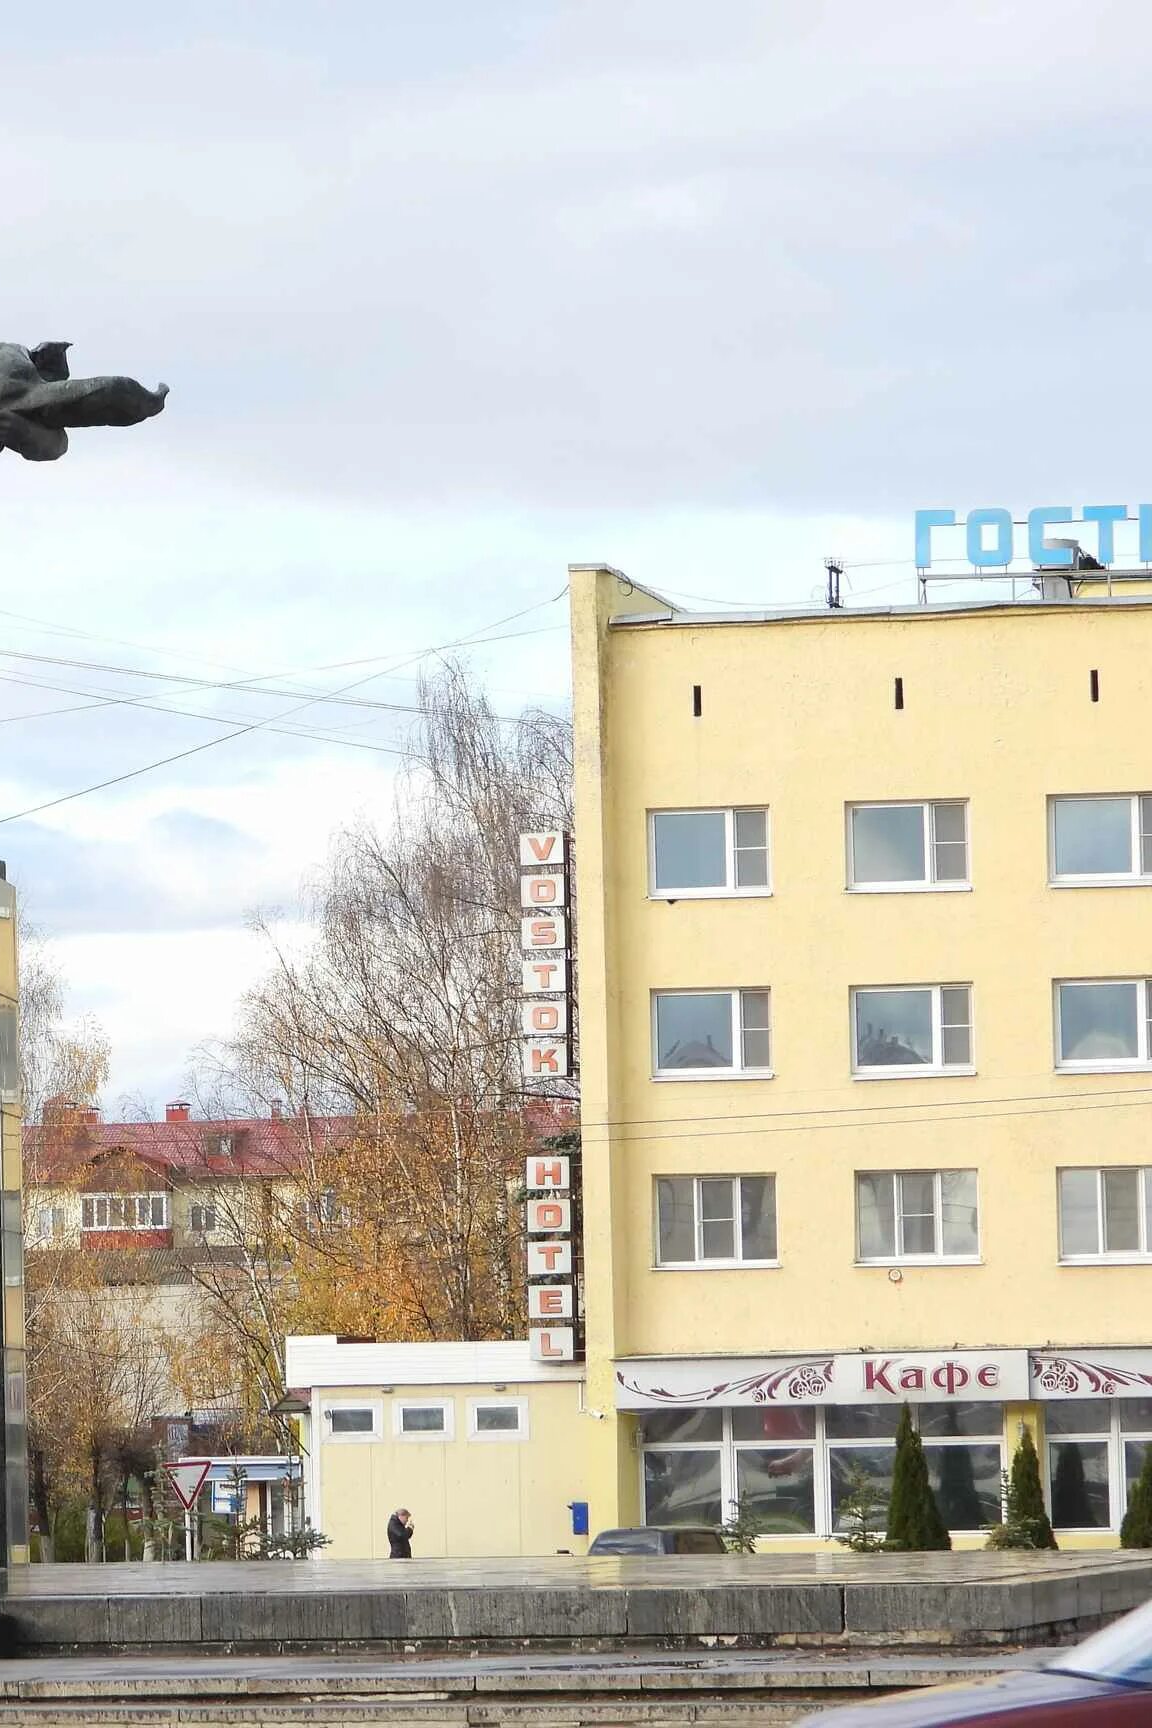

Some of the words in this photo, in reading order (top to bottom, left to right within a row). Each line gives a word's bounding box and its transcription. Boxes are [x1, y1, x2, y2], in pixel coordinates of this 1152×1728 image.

[528, 836, 559, 1073] VOSTOK
[535, 1162, 564, 1357] HOTEL
[862, 1358, 1001, 1396] Кафе
